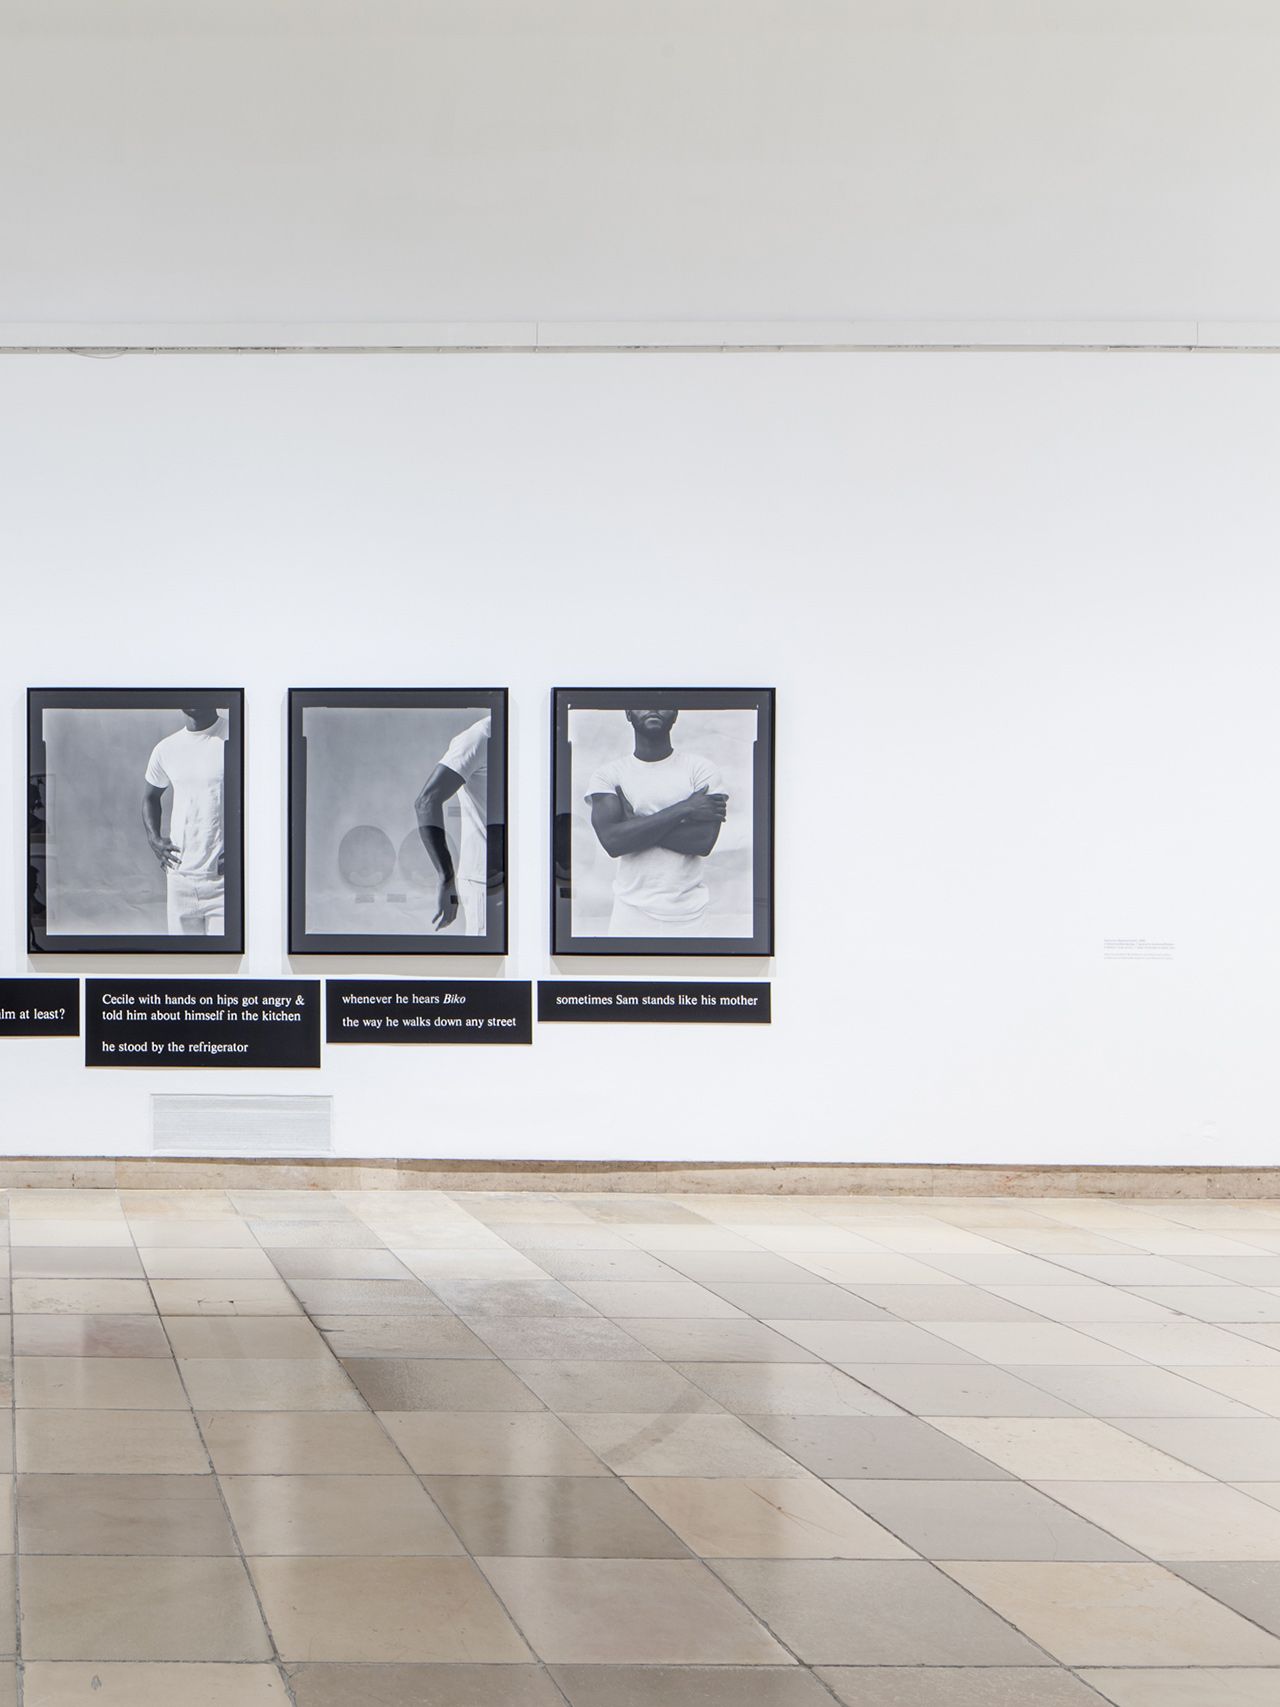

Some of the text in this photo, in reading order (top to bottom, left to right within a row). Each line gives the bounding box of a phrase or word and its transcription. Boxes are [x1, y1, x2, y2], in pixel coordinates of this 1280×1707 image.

[101, 994, 135, 1004] Cecile
[138, 994, 162, 1004] with
[164, 994, 197, 1005] hands
[216, 994, 239, 1006] hips
[241, 996, 259, 1007] got
[261, 997, 292, 1007] angry
[294, 995, 305, 1005] &
[341, 994, 467, 1004] whenever he hears Biko
[555, 995, 759, 1005] sometimes Sam stands like his mother
[19, 1010, 30, 1019] at
[33, 1008, 66, 1019] least?
[102, 1010, 302, 1021] told him about himself in the kitchen
[342, 1017, 517, 1028] the way he walks down any street
[101, 1041, 249, 1054] he stood by the refrigerator
